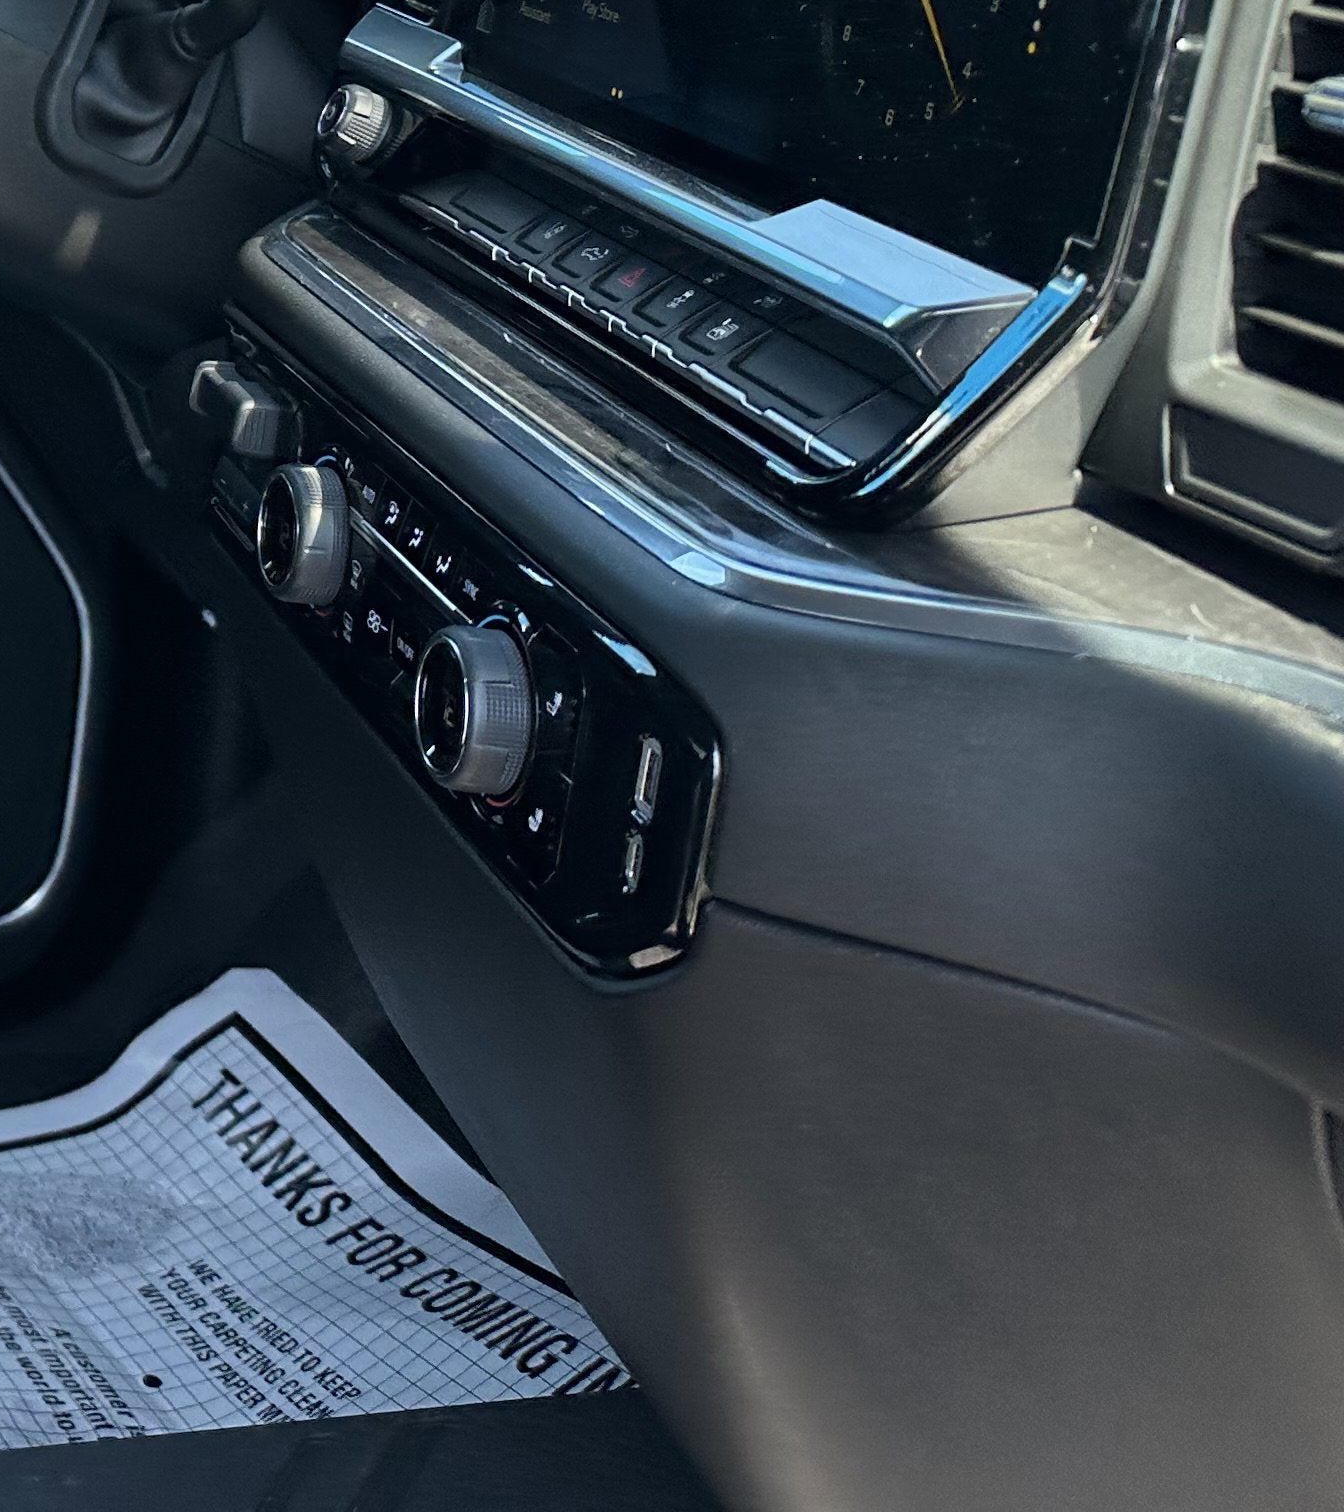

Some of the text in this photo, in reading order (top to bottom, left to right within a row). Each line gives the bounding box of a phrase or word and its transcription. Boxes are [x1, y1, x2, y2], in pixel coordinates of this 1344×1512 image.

[842, 25, 852, 41] 8
[855, 79, 865, 96] 7
[885, 109, 895, 126] 6
[924, 102, 935, 120] 5
[192, 1068, 352, 1228] THANKS
[326, 1217, 425, 1282] FOR
[400, 1267, 579, 1379] COMING
[8, 1303, 48, 1346] most
[38, 1343, 114, 1429] important
[50, 1325, 71, 1339] A
[62, 1341, 135, 1419] customer
[136, 1282, 179, 1330] WITH
[175, 1325, 218, 1363] THIS
[209, 1358, 266, 1409] PAPER
[159, 1267, 208, 1312] YOUR
[198, 1311, 286, 1385] CARPETING
[187, 1258, 361, 1400] WE HAVE TRIED TO KEEP
[16, 1355, 66, 1405] world
[53, 1411, 76, 1430] to
